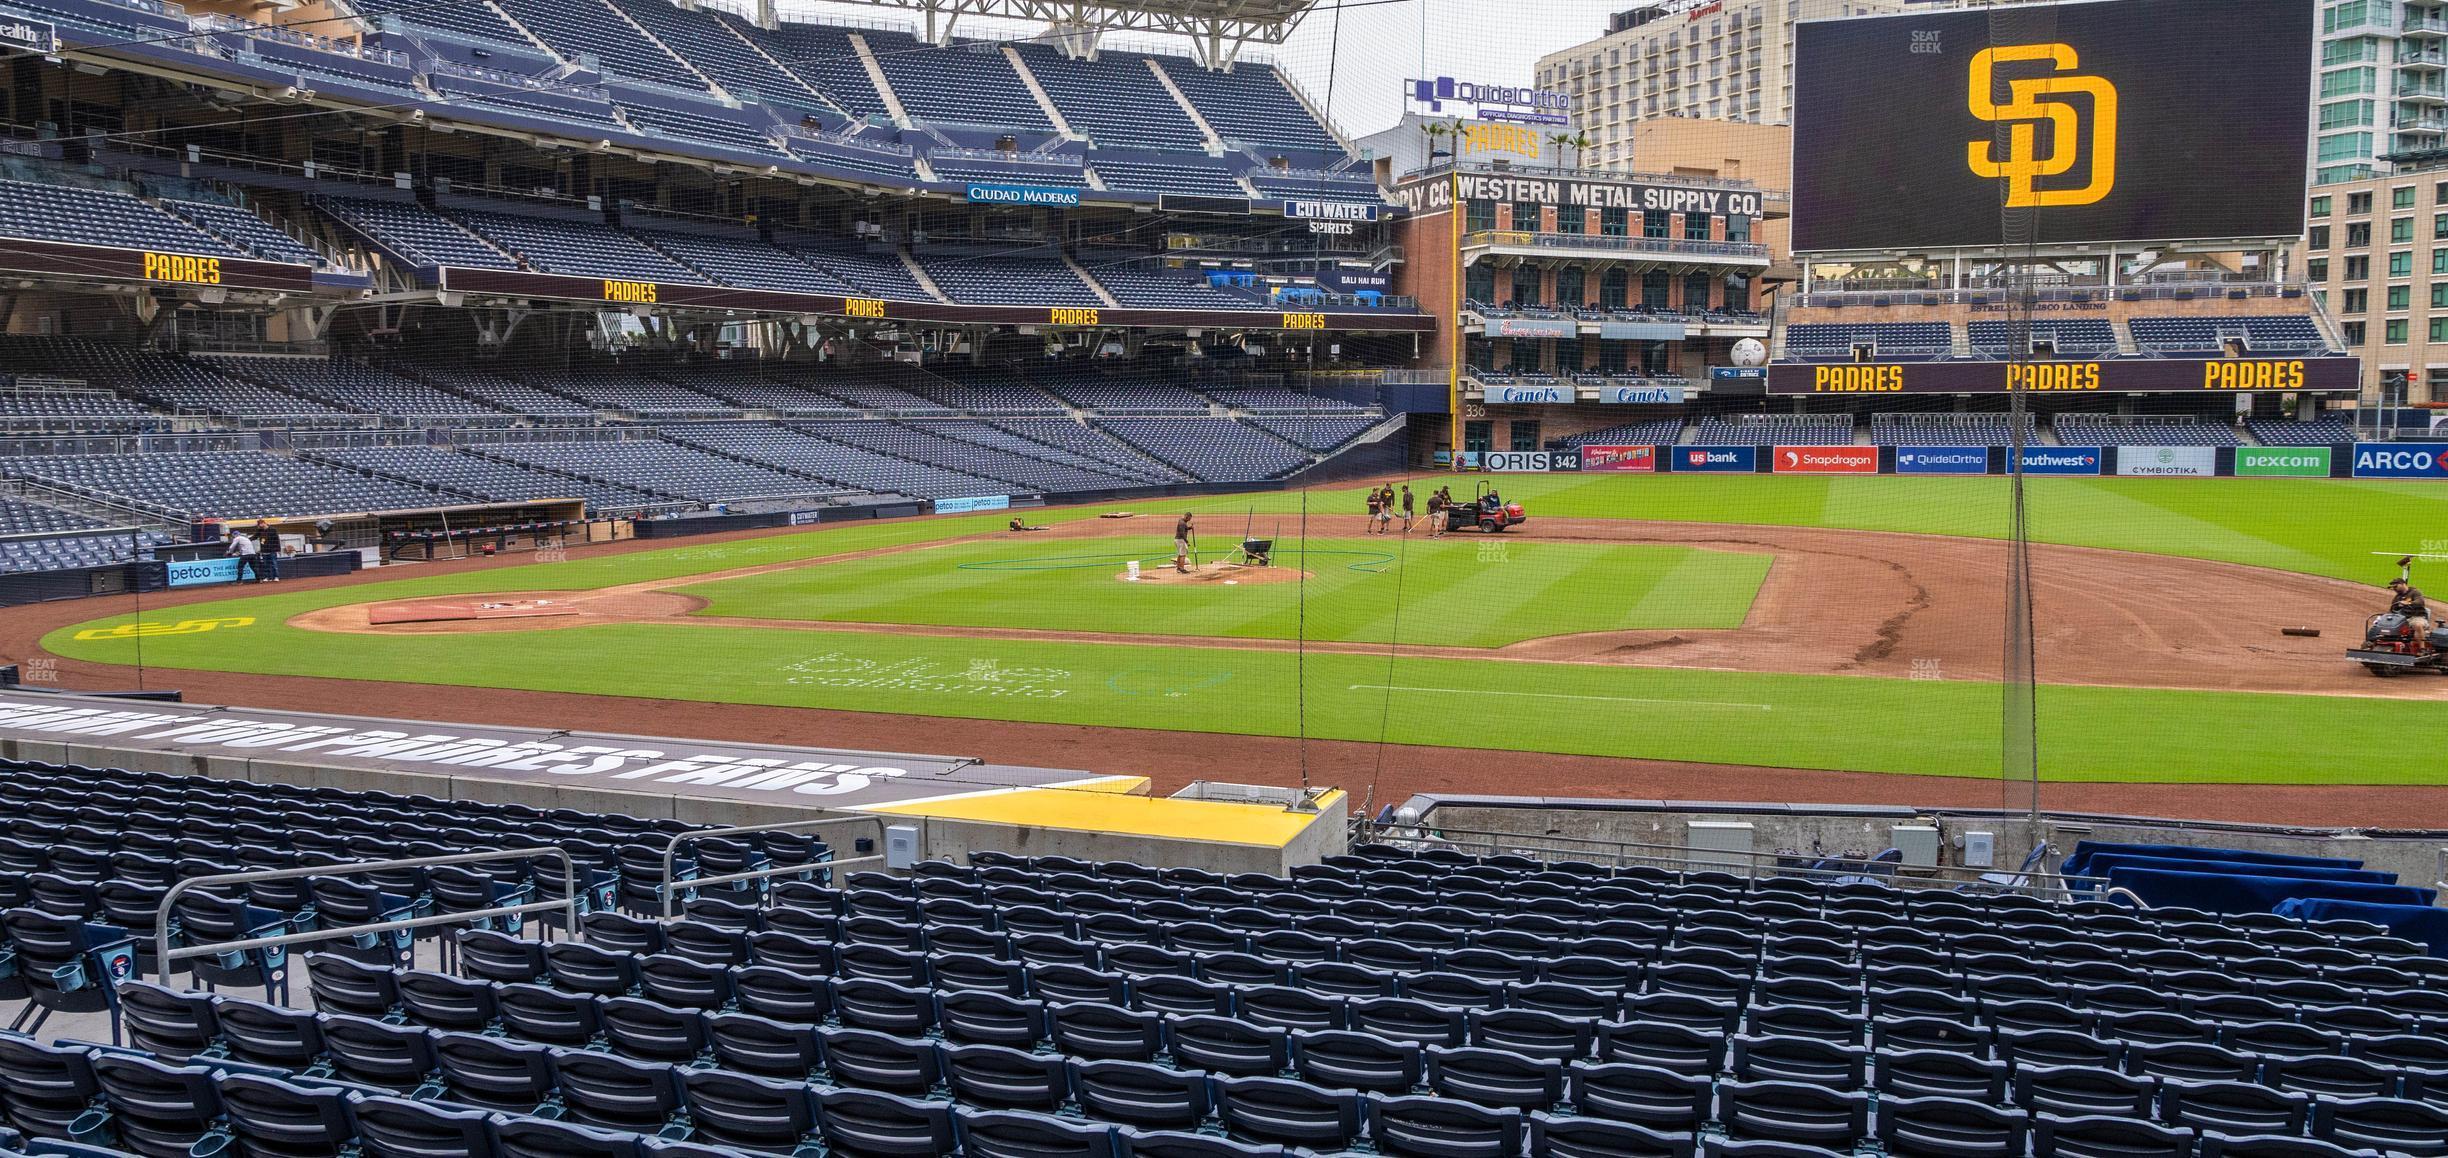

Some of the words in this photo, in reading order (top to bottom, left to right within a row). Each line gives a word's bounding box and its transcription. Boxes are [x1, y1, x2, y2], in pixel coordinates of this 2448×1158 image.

[0, 22, 37, 42] ealth
[1460, 81, 1569, 109] QuidelOrtho
[1482, 111, 1506, 119] OFFICIAL
[1542, 115, 1566, 123] PARTNER
[1968, 43, 2118, 208] SD
[1465, 124, 1540, 159] PADRES
[970, 187, 1020, 201] CIUDAD
[1023, 190, 1077, 204] MADERAS
[1393, 186, 1425, 212] PLY
[1430, 180, 1453, 208] CO.
[1456, 175, 1559, 204] WESTERN
[1570, 183, 1638, 208] METAL
[1644, 188, 1722, 213] SUPPLY
[1728, 193, 1761, 216] CO.
[1296, 201, 1368, 220] CUTWATER
[1310, 222, 1353, 235] SPIRITS
[144, 252, 221, 284] PADRES
[1341, 276, 1357, 285] BALI
[1358, 277, 1370, 285] HAI
[1370, 277, 1386, 285] RUM
[604, 279, 657, 303] PADRES
[845, 297, 885, 318] PADRES
[1970, 304, 2018, 313] ESTRELA
[2020, 303, 2060, 312] JLISCO
[2062, 303, 2107, 311] LANDING
[1051, 308, 1098, 325] PADRES
[1283, 313, 1325, 329] PADRES
[1815, 365, 1904, 392] PADRES
[2006, 362, 2100, 391] PADRES
[2204, 360, 2305, 389] PADRES
[1502, 386, 1560, 402] Canel's
[1617, 386, 1670, 402] Canel's
[1466, 404, 1486, 417] 336
[1488, 453, 1548, 470] ORIS
[1555, 455, 1577, 468] 342
[1690, 453, 1705, 463] us
[1706, 452, 1738, 463] bank
[1803, 454, 1871, 466] Snapdragon
[1917, 455, 1983, 465] QuidelOrtho
[2356, 451, 2432, 470] ARCO
[2132, 466, 2198, 474] CYMBIOTIKA
[935, 502, 954, 511] petco
[974, 499, 991, 507] petco
[170, 565, 211, 584] petco
[0, 703, 208, 736] HANK
[132, 718, 356, 748] YOU
[277, 730, 665, 775] PADRES
[609, 754, 908, 795] FANS
